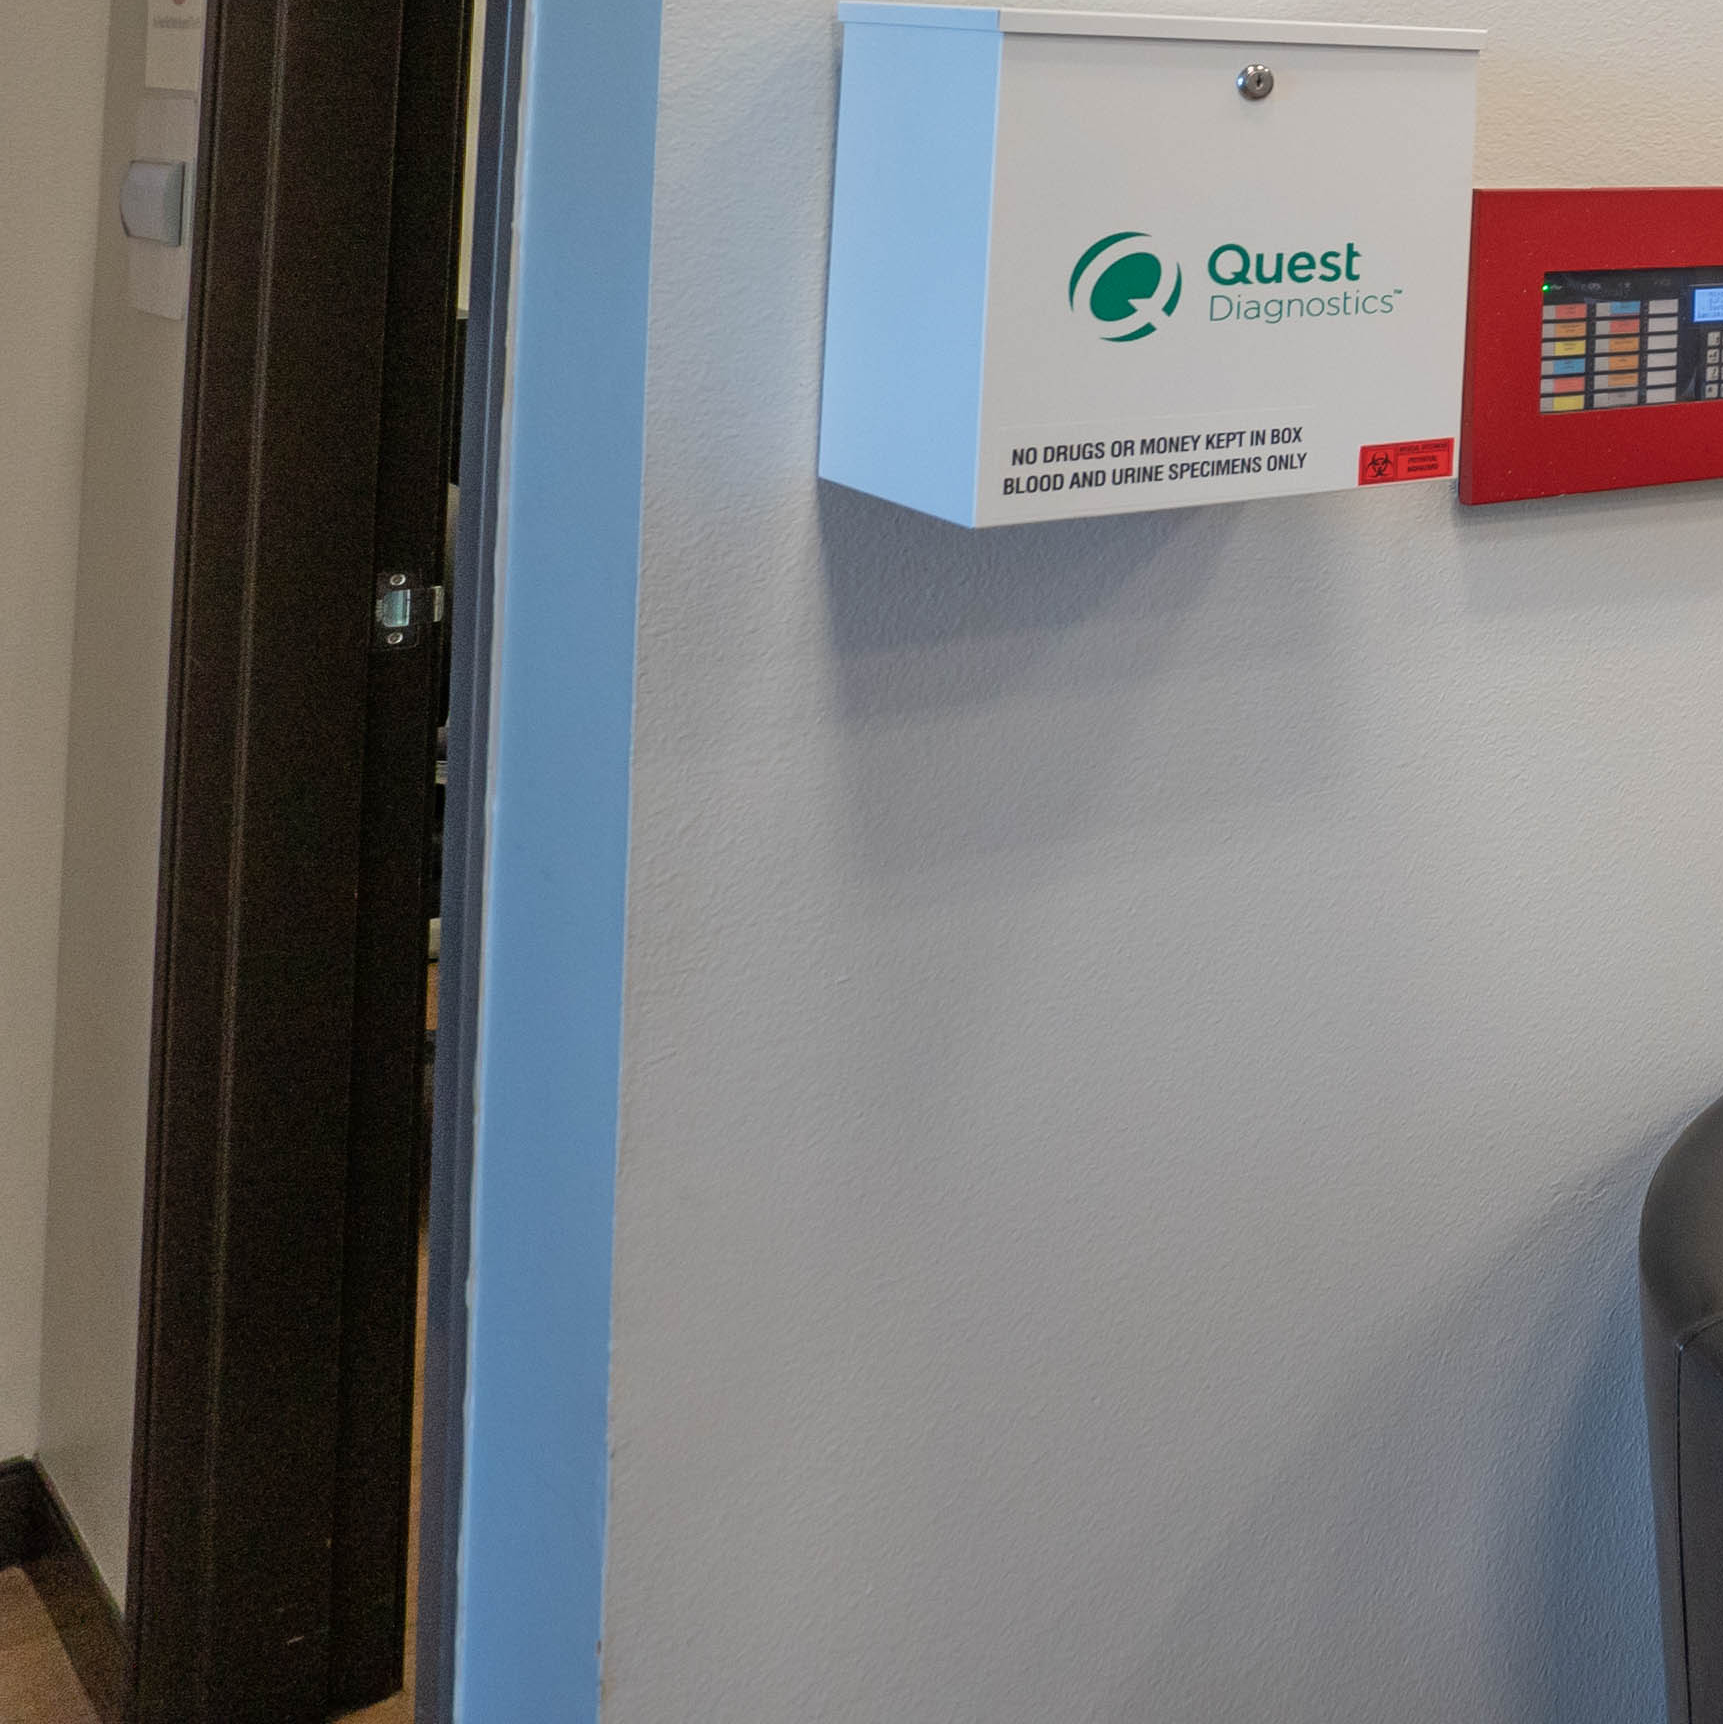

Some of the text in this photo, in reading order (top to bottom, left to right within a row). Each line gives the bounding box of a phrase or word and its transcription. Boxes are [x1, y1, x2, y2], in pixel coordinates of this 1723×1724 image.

[1207, 242, 1361, 285] Quest
[1011, 426, 1302, 466] NO DRUGS OR MONEY KEPT IN BOX
[1003, 453, 1307, 496] BLOOD AND URINE SPECIMENS ONLY
